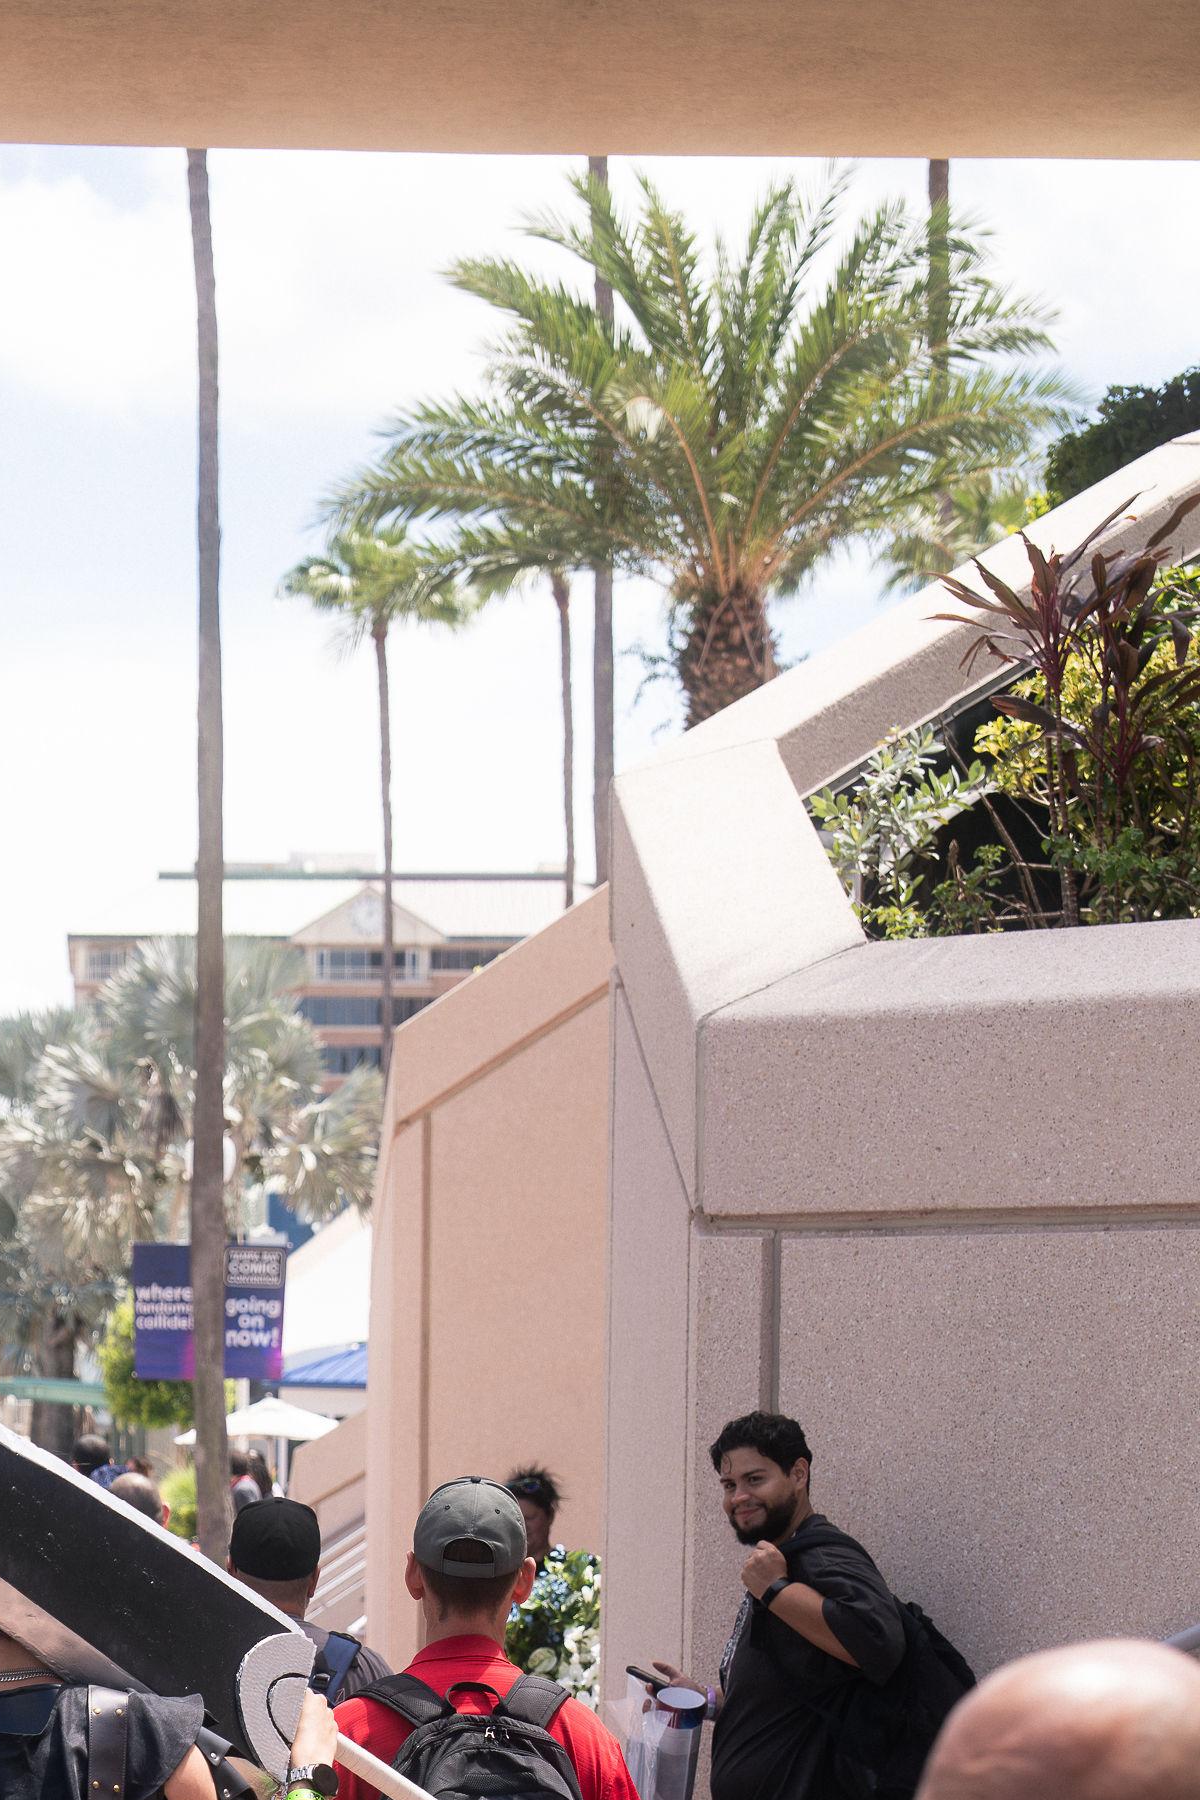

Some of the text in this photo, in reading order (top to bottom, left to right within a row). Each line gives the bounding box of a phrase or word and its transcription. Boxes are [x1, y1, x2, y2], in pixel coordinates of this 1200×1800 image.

[228, 1261, 280, 1275] COMIC
[135, 1282, 193, 1301] where
[225, 1295, 282, 1317] going
[238, 1314, 265, 1329] on
[225, 1327, 280, 1348] now!
